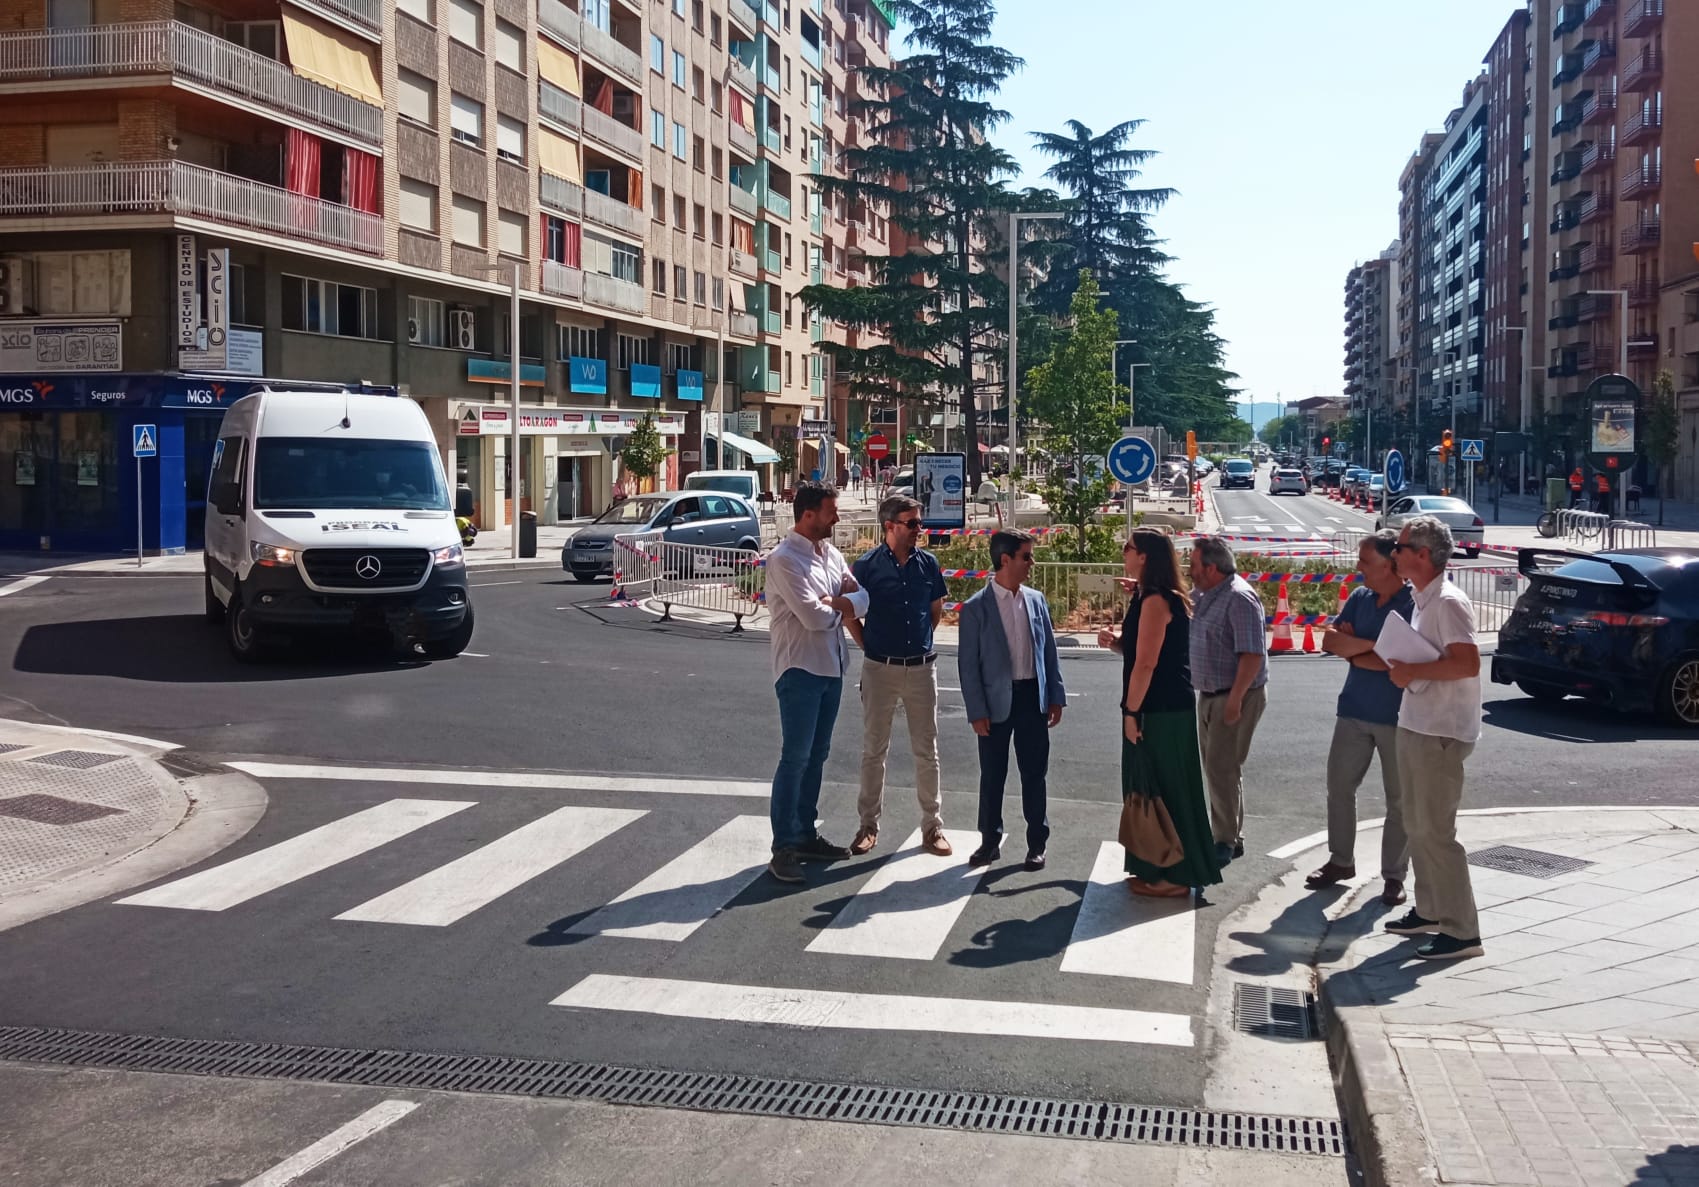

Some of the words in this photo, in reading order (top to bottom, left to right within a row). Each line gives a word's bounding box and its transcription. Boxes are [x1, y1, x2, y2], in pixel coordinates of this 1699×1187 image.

[181, 237, 192, 276] CENTRO
[181, 290, 192, 344] ESTUDIOS
[0, 389, 34, 402] MGS
[91, 390, 126, 401] Seguros
[187, 389, 213, 404] MGS
